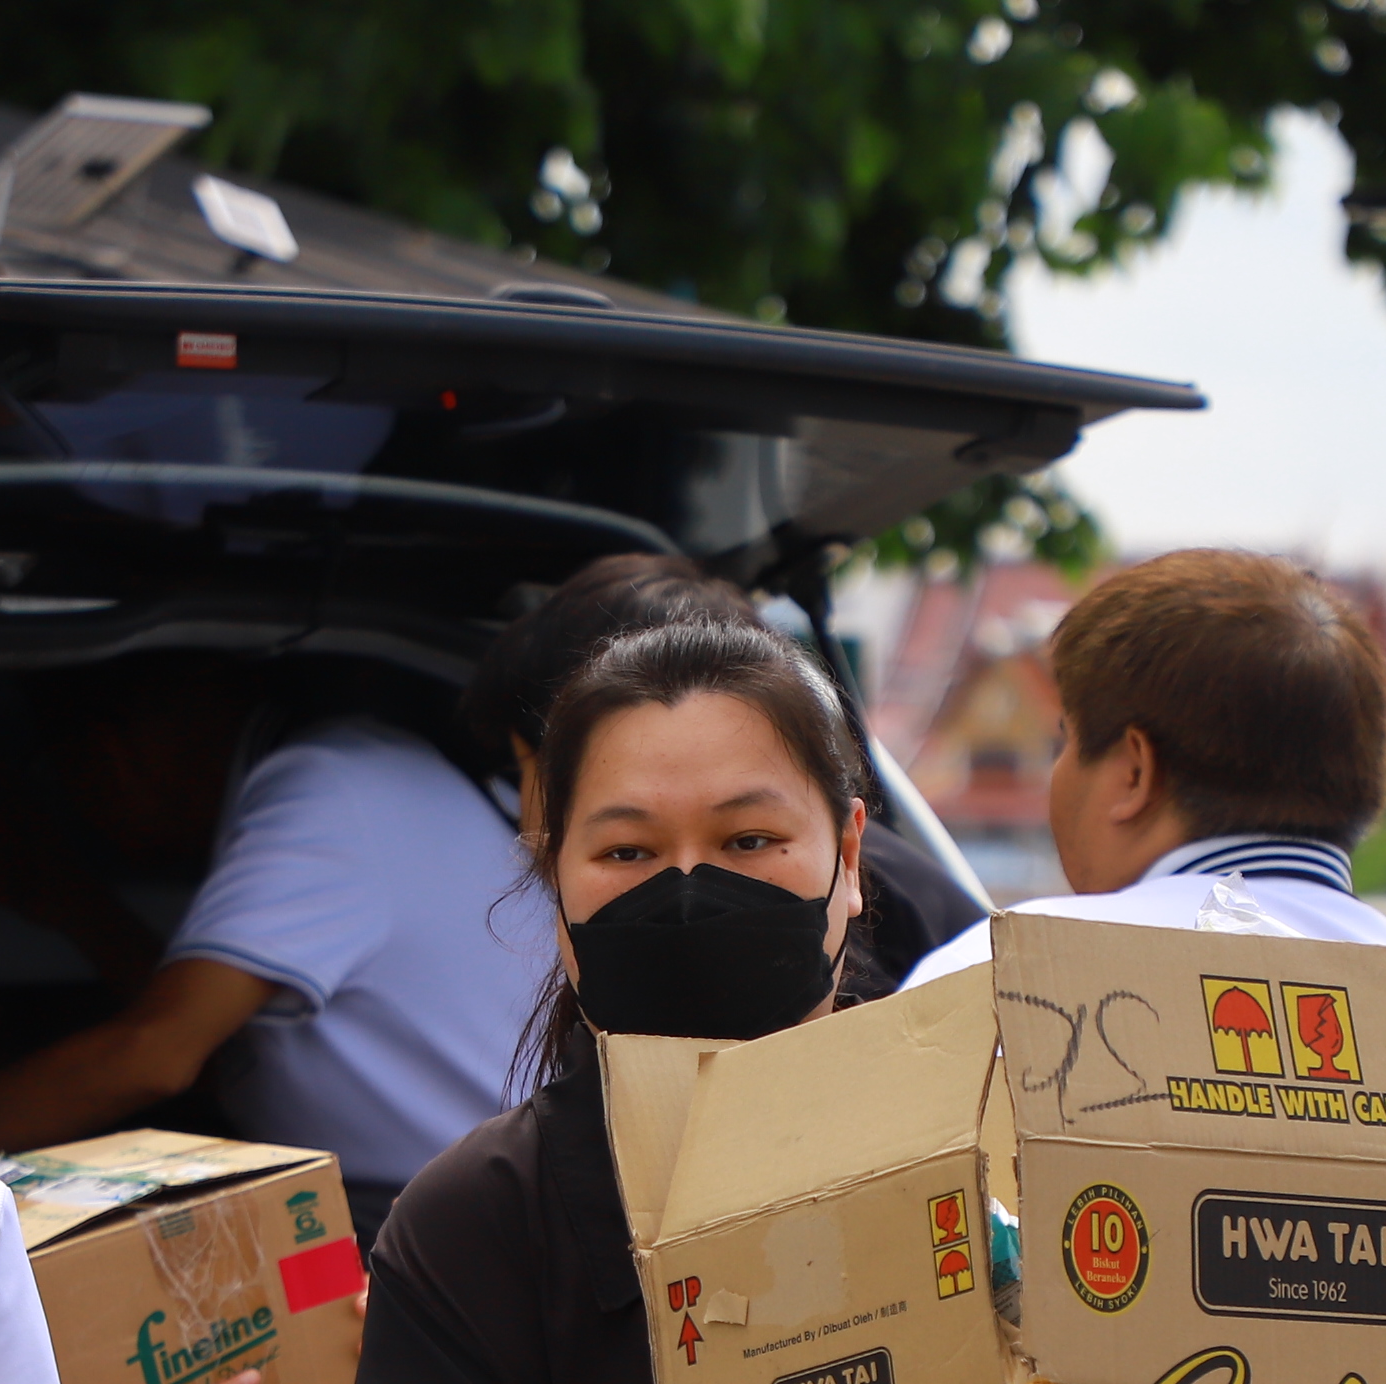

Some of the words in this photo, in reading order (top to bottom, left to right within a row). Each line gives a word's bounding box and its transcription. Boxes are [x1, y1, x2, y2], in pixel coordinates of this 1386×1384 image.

[1166, 1076, 1276, 1119] HANDLE
[1276, 1084, 1351, 1125] WITH
[1067, 1189, 1097, 1225] LEBIH
[1101, 1186, 1143, 1231] PILIHAN
[1090, 1211, 1125, 1252] 10
[1222, 1214, 1318, 1262] HWA
[1086, 1270, 1127, 1284] Beraneka
[1092, 1257, 1120, 1270] Biskut
[667, 1275, 703, 1313] UP
[1074, 1280, 1104, 1309] LEBIH
[1269, 1278, 1309, 1300] Since
[1312, 1280, 1348, 1303] 1962
[743, 1333, 802, 1360] Manufactured
[804, 1330, 816, 1342] By
[823, 1318, 851, 1336] Dibuat
[853, 1311, 874, 1326] Oleh
